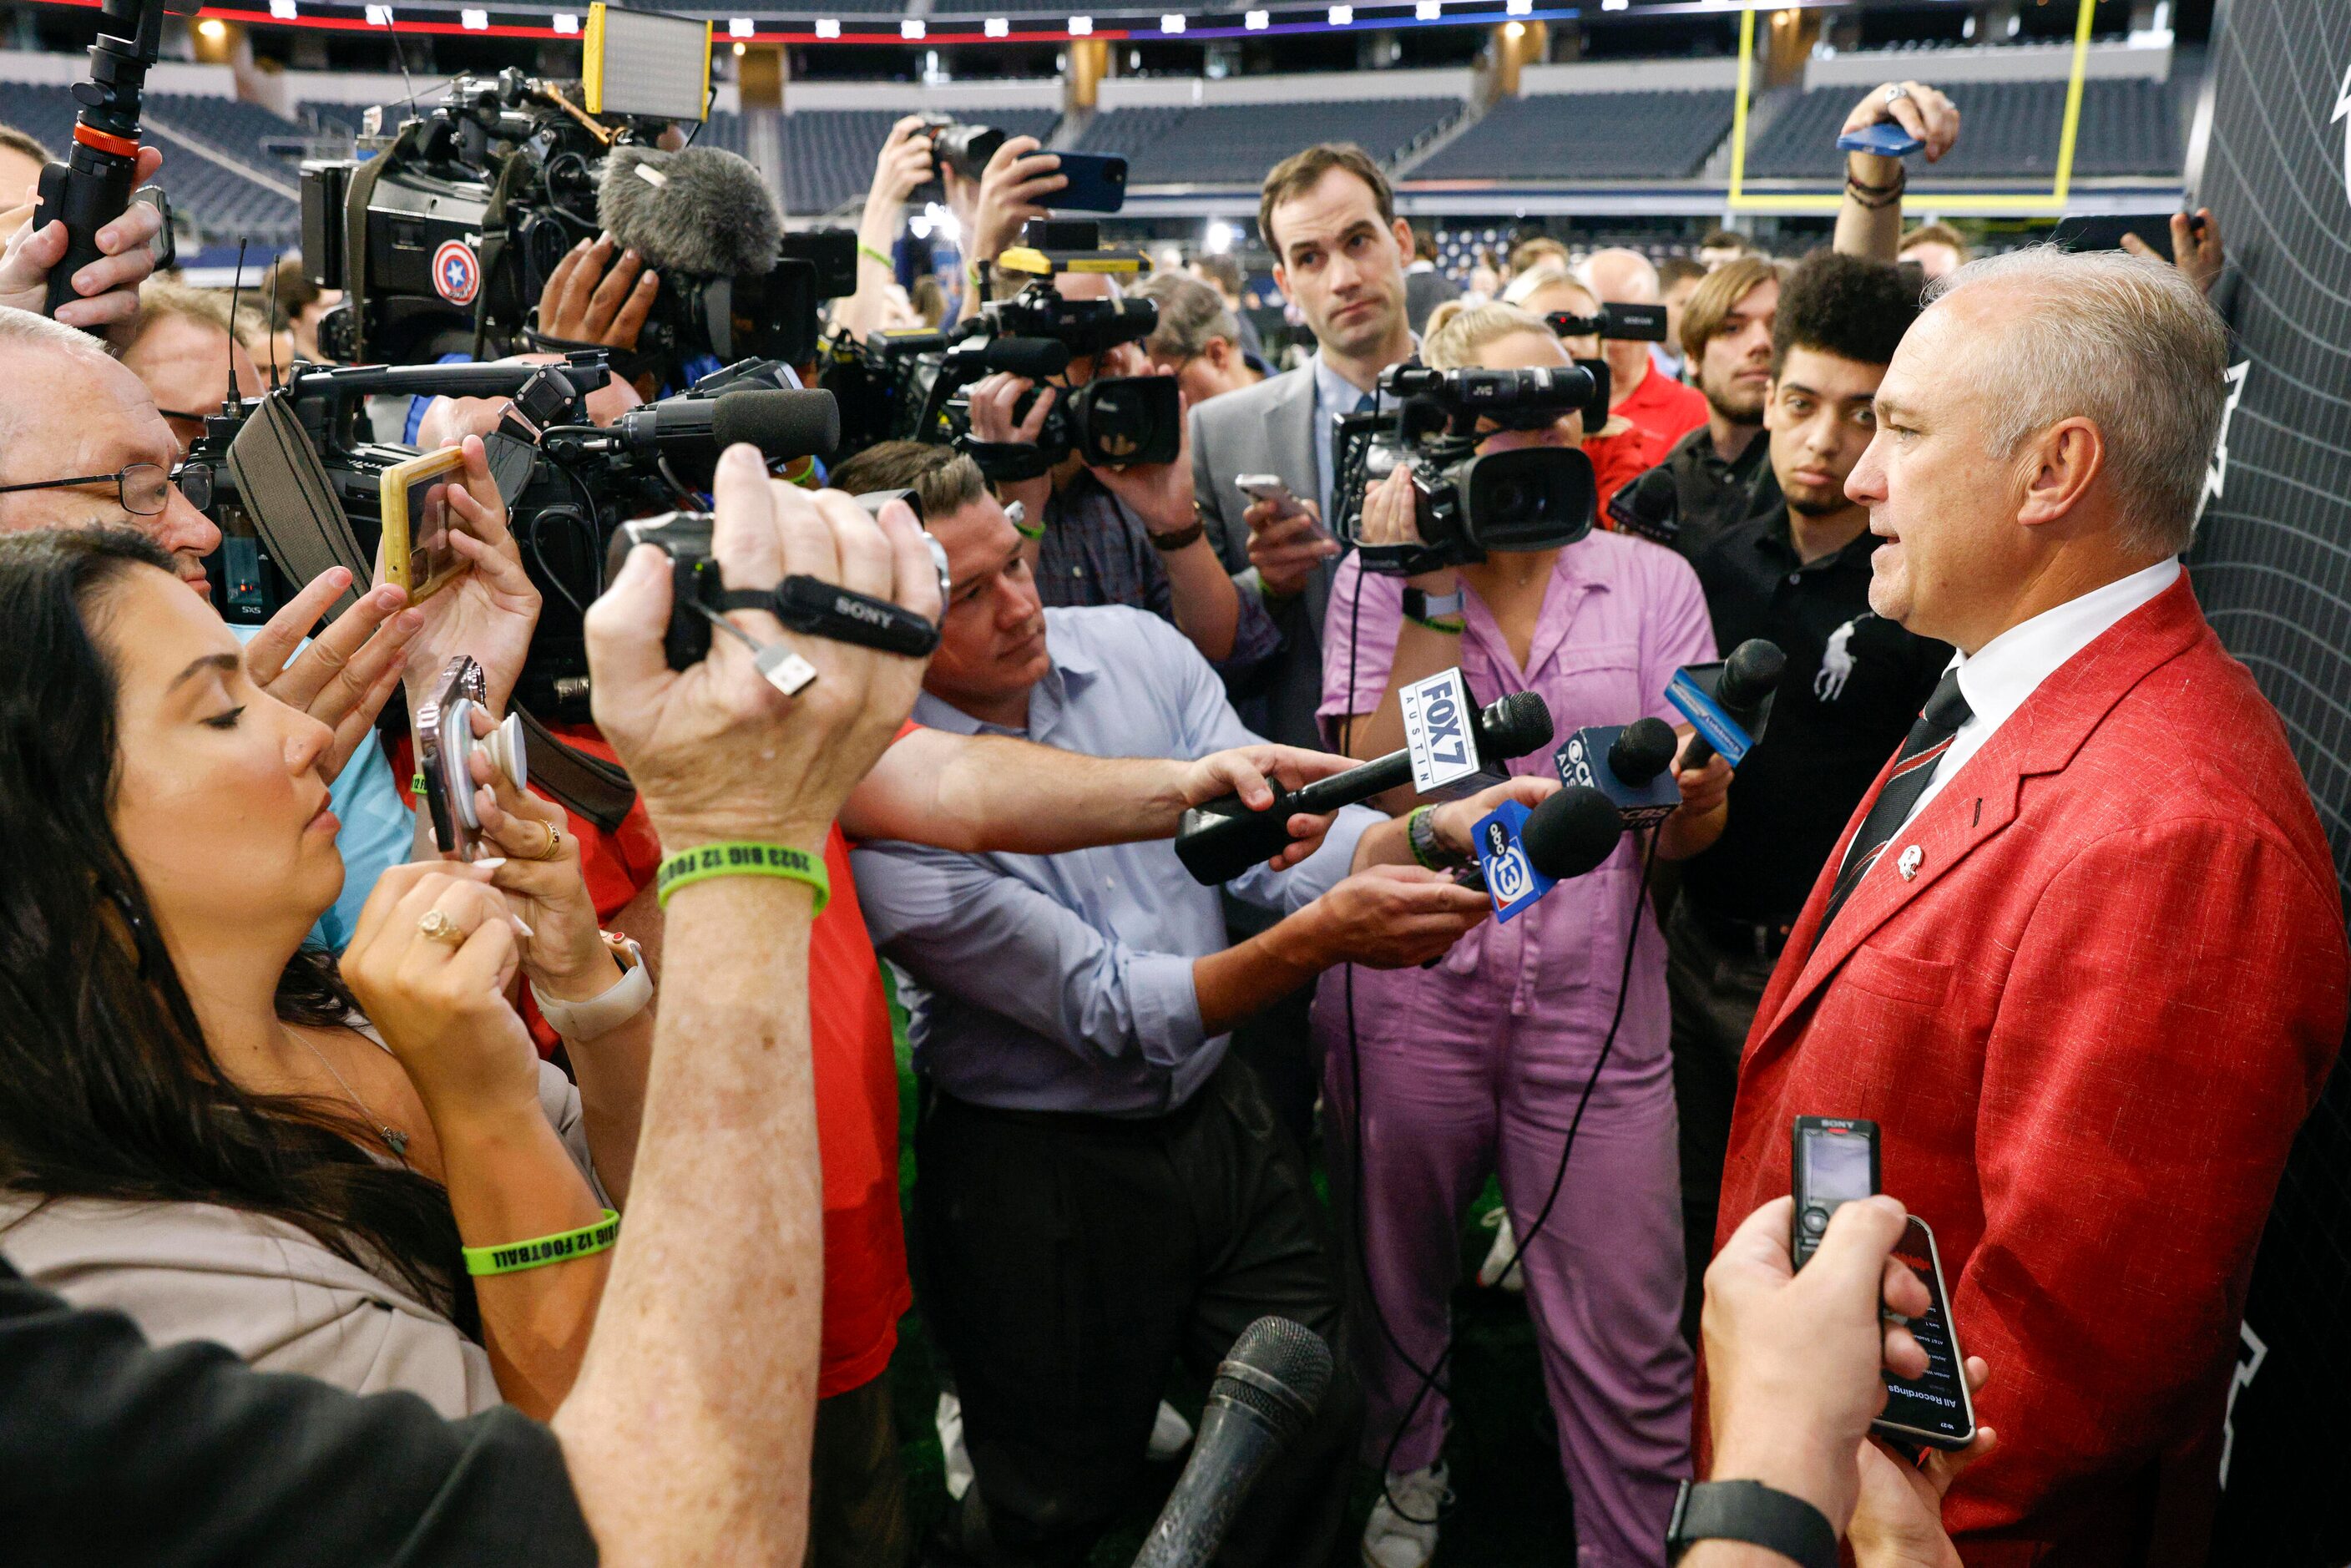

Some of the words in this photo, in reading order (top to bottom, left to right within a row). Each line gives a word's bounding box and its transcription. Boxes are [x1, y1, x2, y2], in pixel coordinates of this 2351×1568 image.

[1473, 385, 1493, 397] JVC
[835, 595, 893, 629] SONY
[1406, 696, 1429, 781] AUSTIN
[1557, 753, 1576, 788] AUS
[1489, 823, 1505, 855] abc
[701, 848, 722, 869] 12
[729, 847, 763, 866] BIG
[768, 847, 811, 873] 2023
[1496, 853, 1520, 896] 13
[1821, 1119, 1855, 1129] SONY
[492, 1237, 574, 1267] FOOTBALL
[577, 1232, 594, 1251] 12
[1888, 1385, 1943, 1405] Recordings
[1944, 1398, 1956, 1409] All
[1940, 1422, 1954, 1430] 10:27
